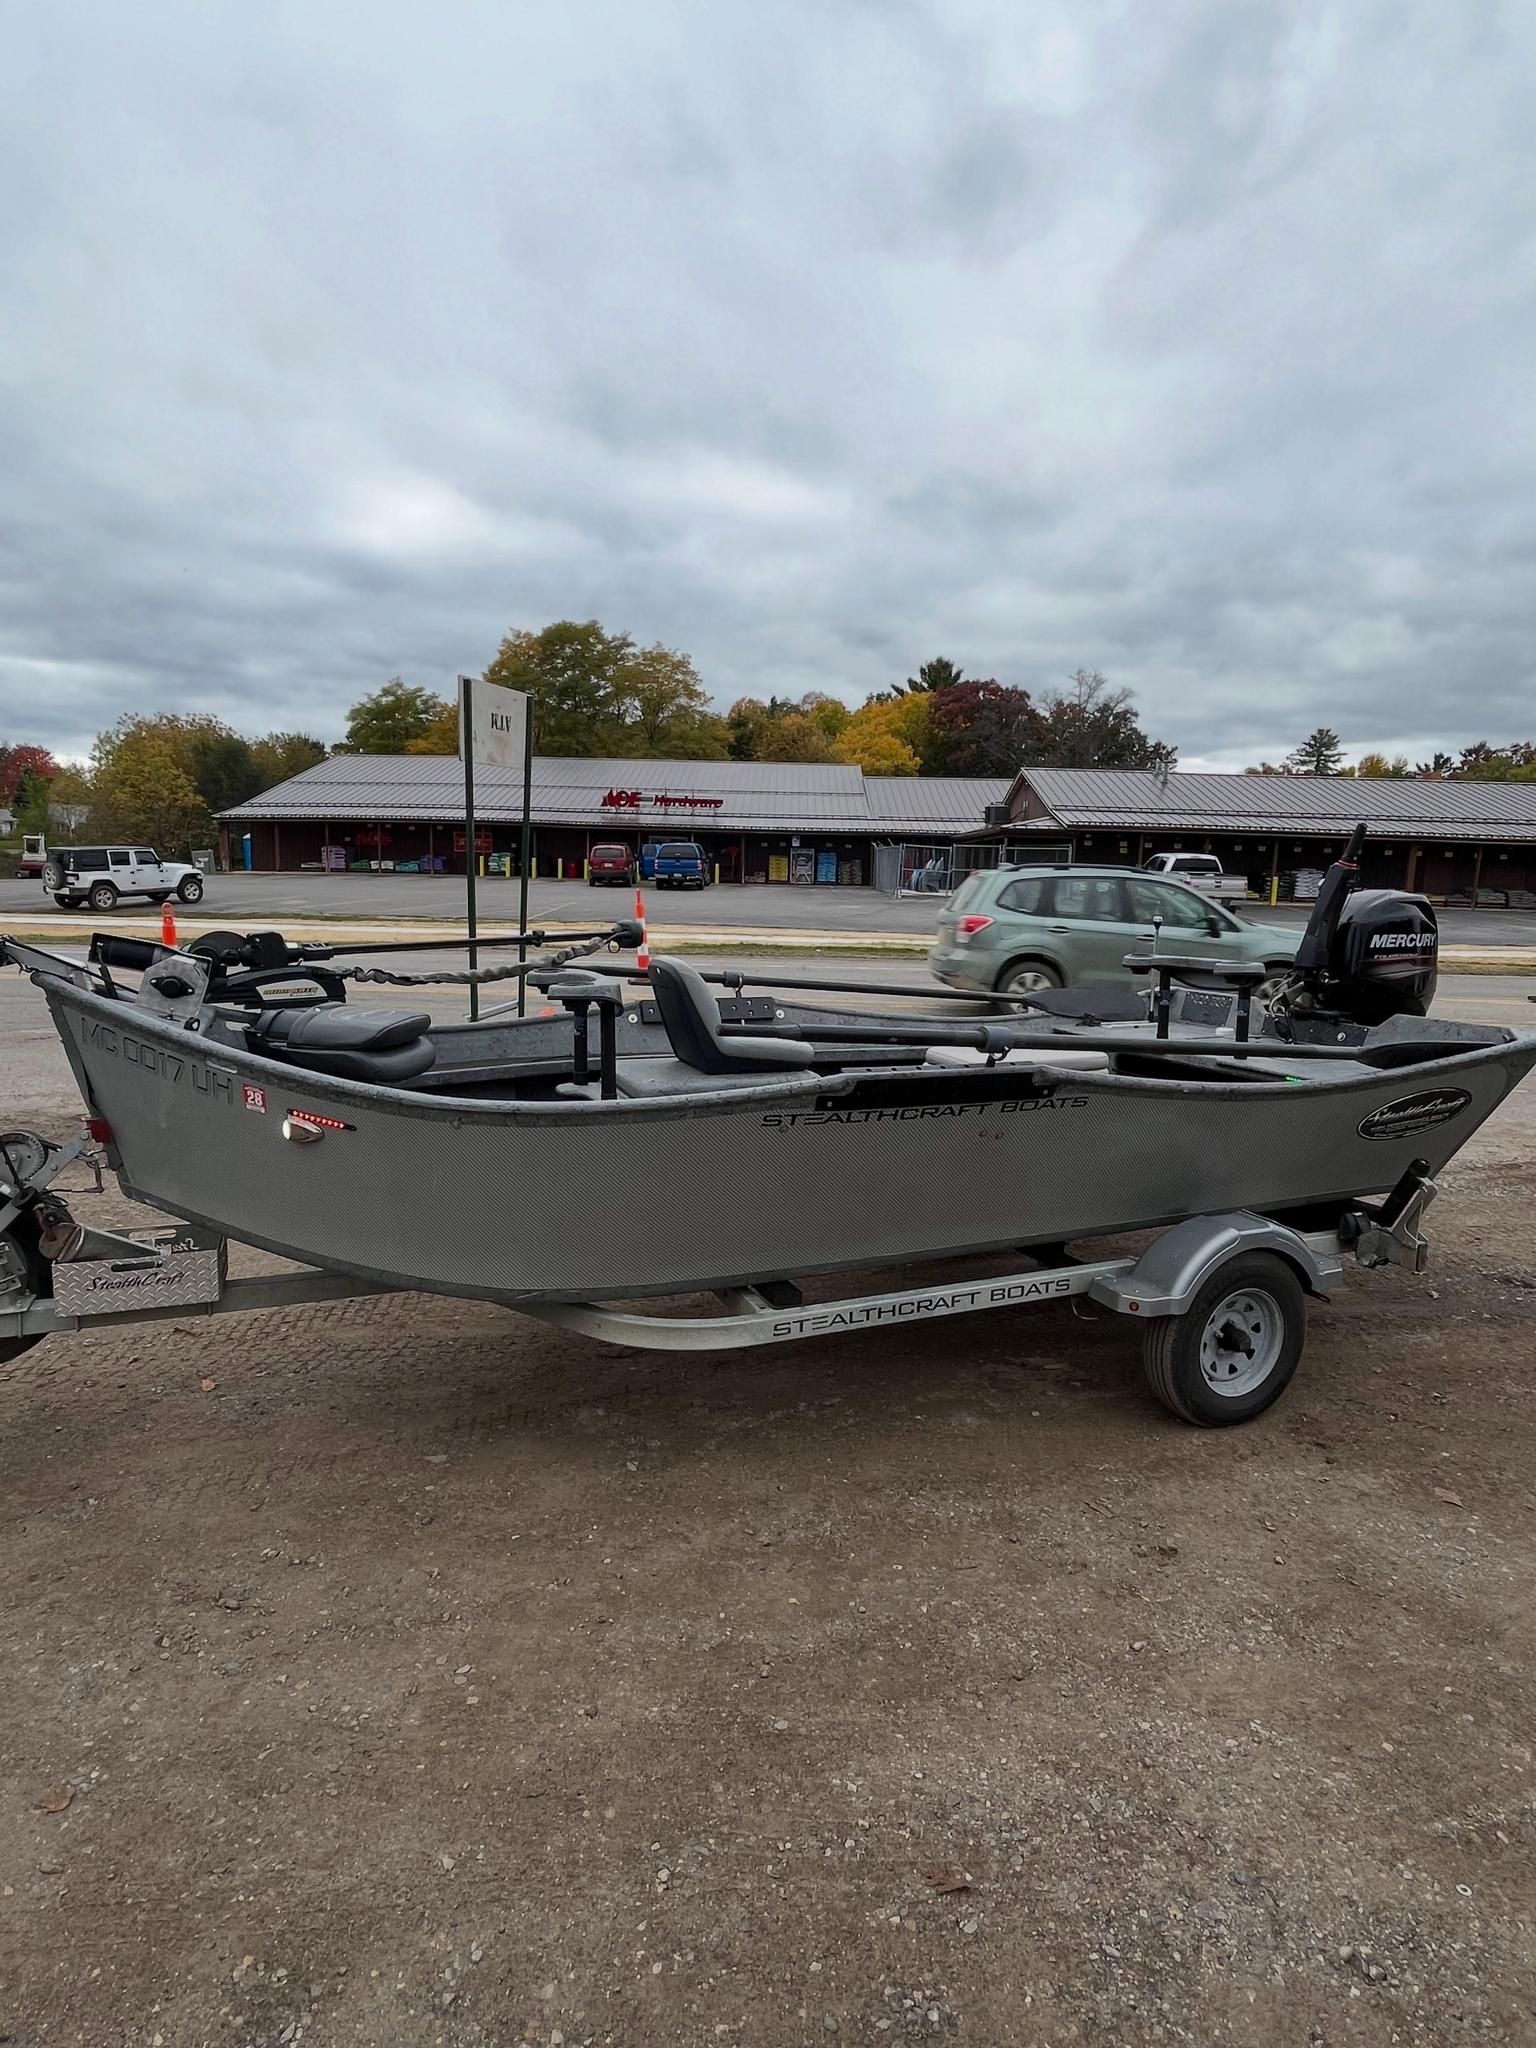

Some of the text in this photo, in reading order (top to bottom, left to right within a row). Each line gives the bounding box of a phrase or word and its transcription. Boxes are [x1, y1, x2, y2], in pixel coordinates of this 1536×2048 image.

[600, 788, 724, 808] ACE Hardware
[1370, 933, 1436, 948] MERCURY
[761, 1095, 1089, 1127] STEALTHCRAFT BOATS
[86, 1270, 186, 1292] StealthCraft
[773, 1278, 1071, 1337] STEALTHCRAFT BOATS
